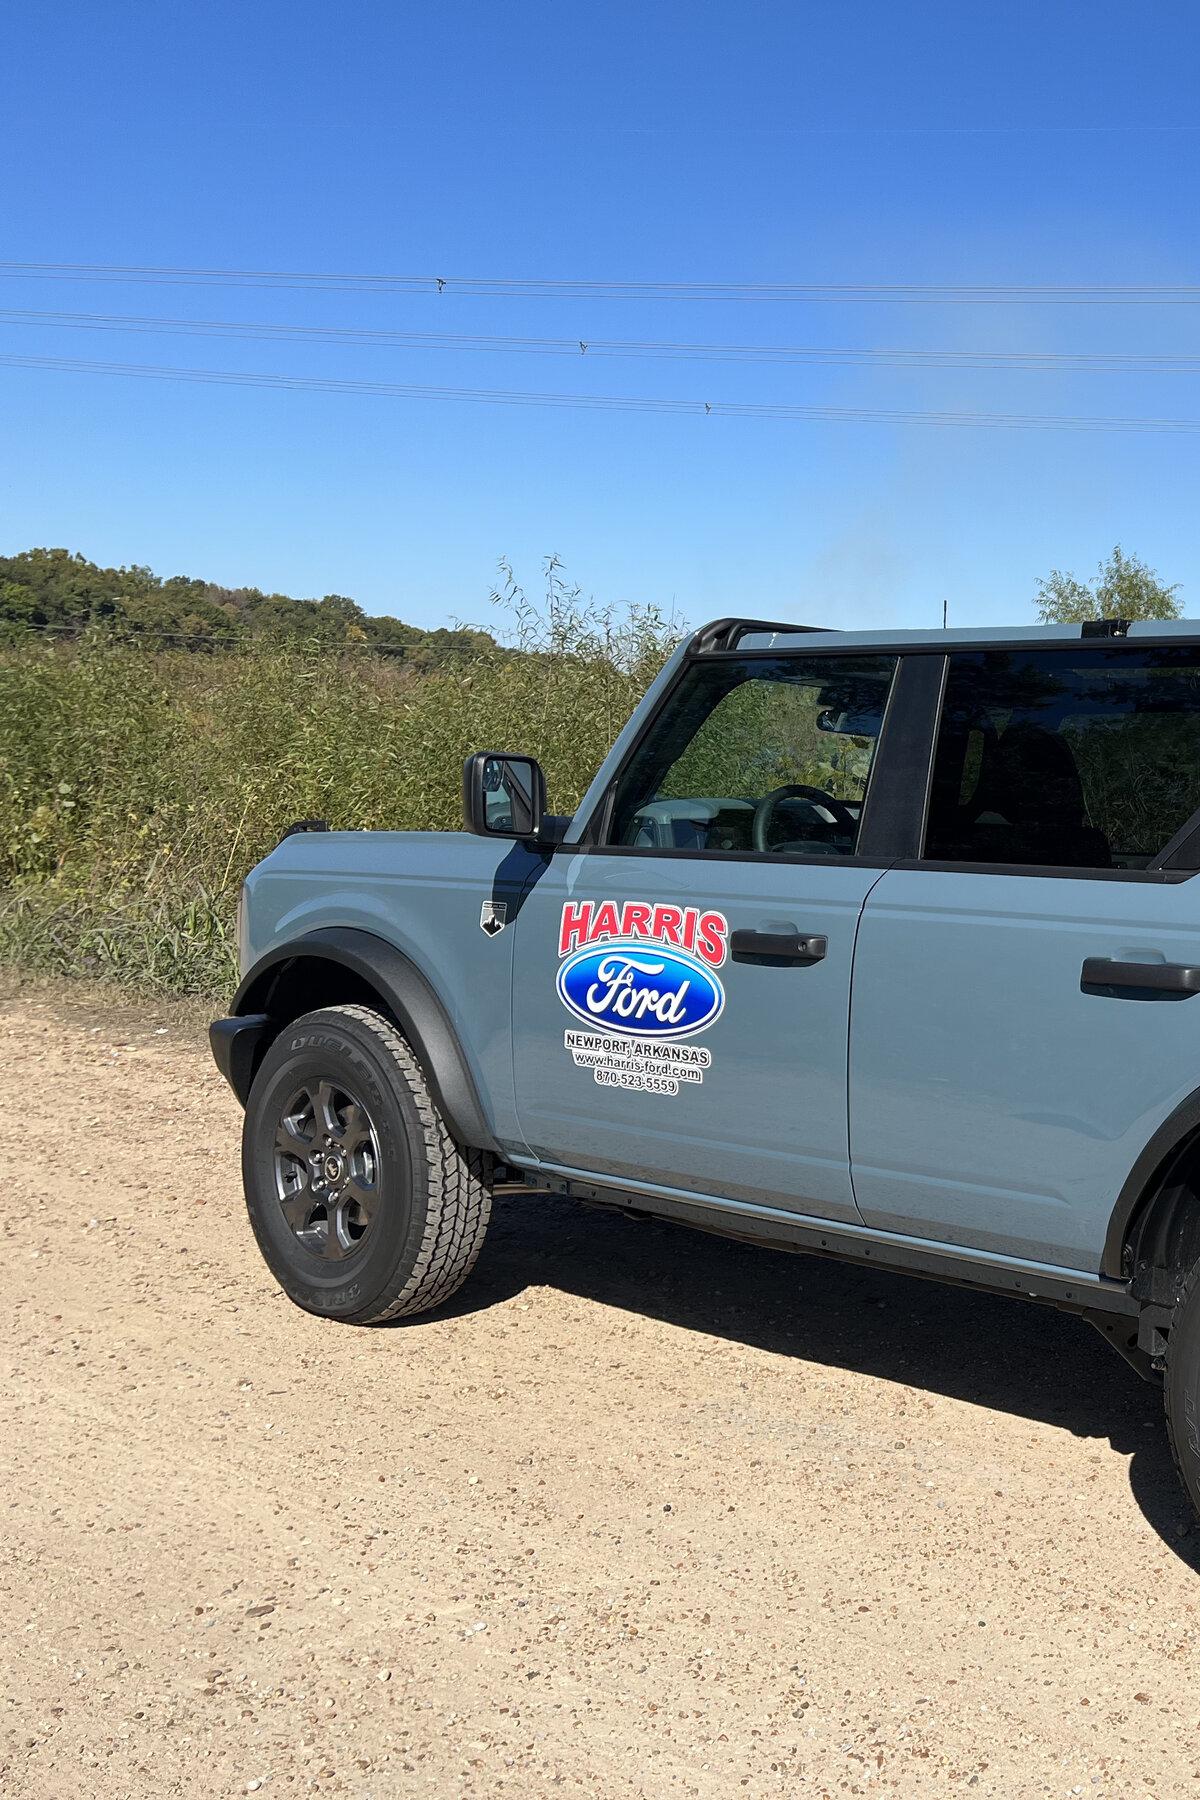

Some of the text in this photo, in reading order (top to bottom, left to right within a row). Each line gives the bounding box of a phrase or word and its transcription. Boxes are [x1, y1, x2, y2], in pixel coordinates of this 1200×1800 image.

[559, 902, 727, 968] HARRIS
[586, 955, 691, 1024] Ford
[566, 1034, 709, 1064] NEWPORT, ARKANSAS
[574, 1053, 701, 1080] www.harris-ford.com
[596, 1070, 676, 1093] 870-523-5559
